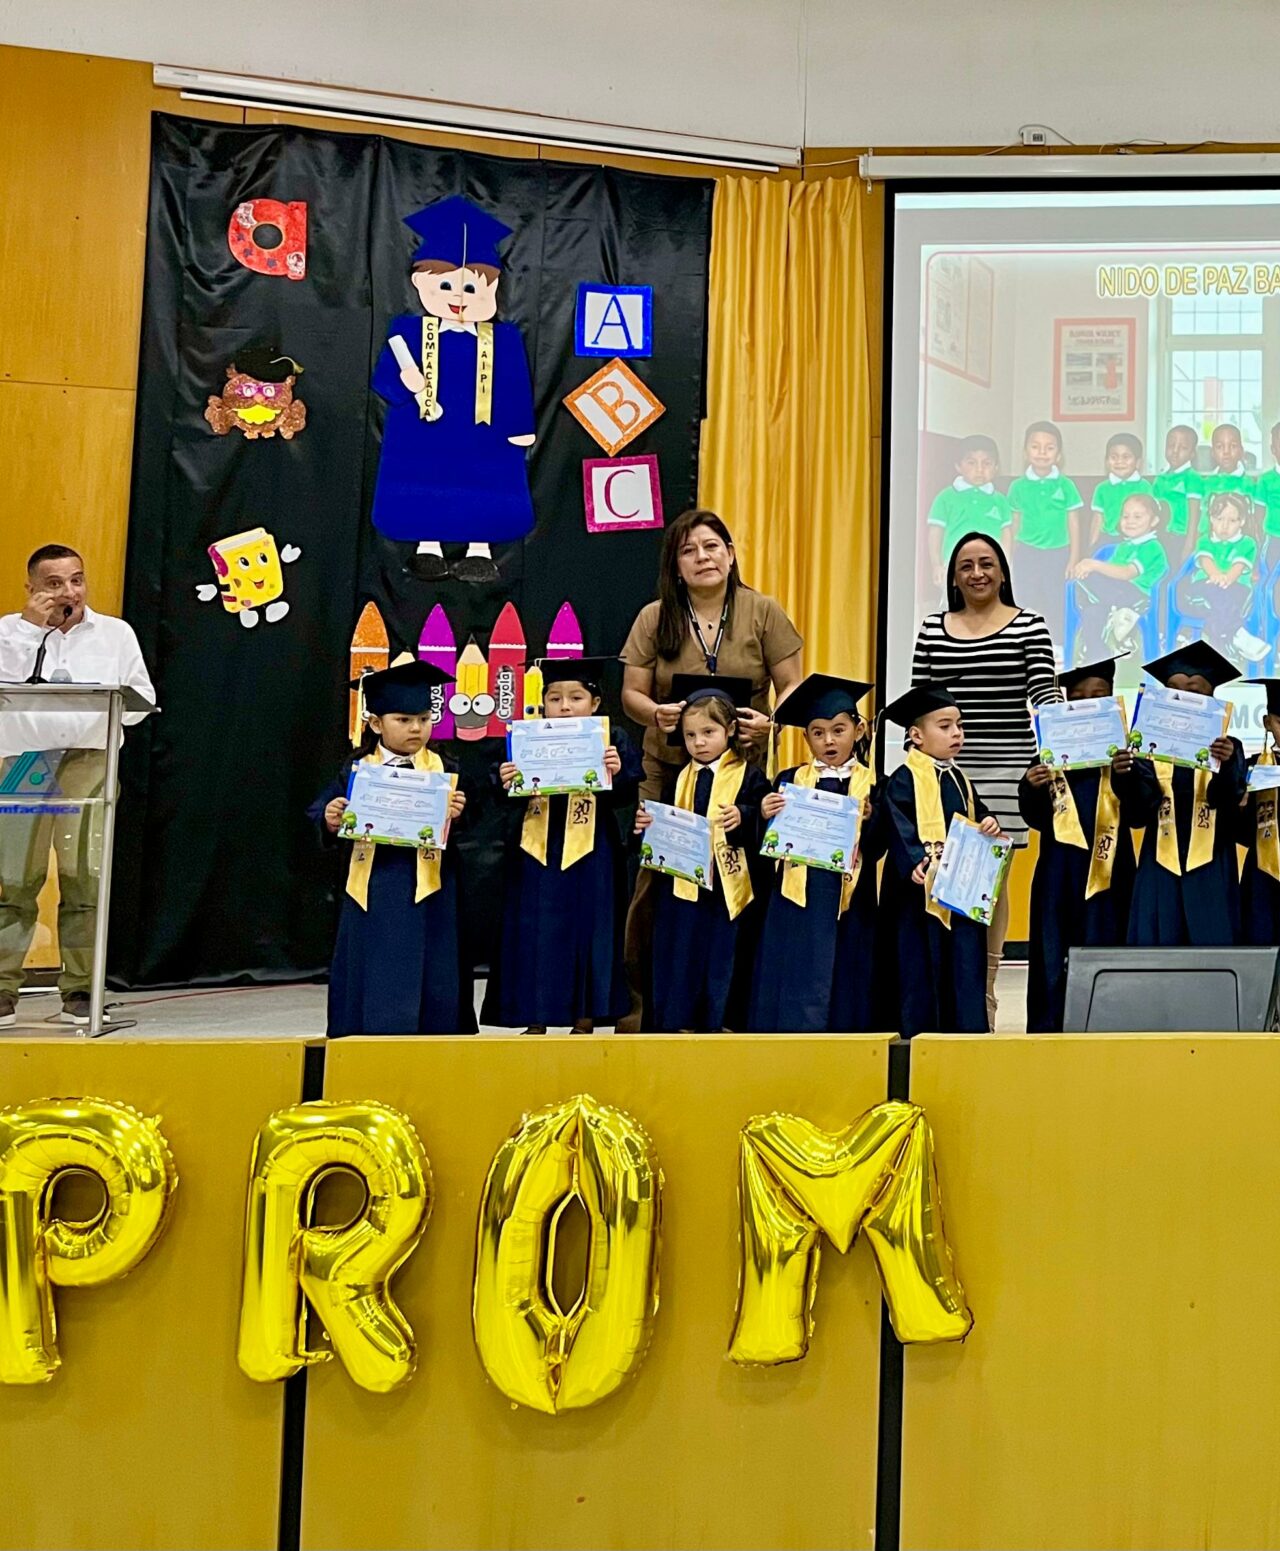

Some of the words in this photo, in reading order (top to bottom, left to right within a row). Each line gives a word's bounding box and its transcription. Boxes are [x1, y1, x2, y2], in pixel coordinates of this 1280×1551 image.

[1098, 265, 1160, 297] NIDO
[1163, 266, 1199, 296] DE
[1203, 264, 1249, 296] PAZ
[591, 294, 636, 349] A
[423, 322, 436, 417] COMFACAUCA
[480, 350, 488, 394] AIPI
[586, 380, 641, 436] B
[603, 468, 641, 519] C
[497, 672, 512, 720] Crayola
[0, 1094, 975, 1417] PROM
